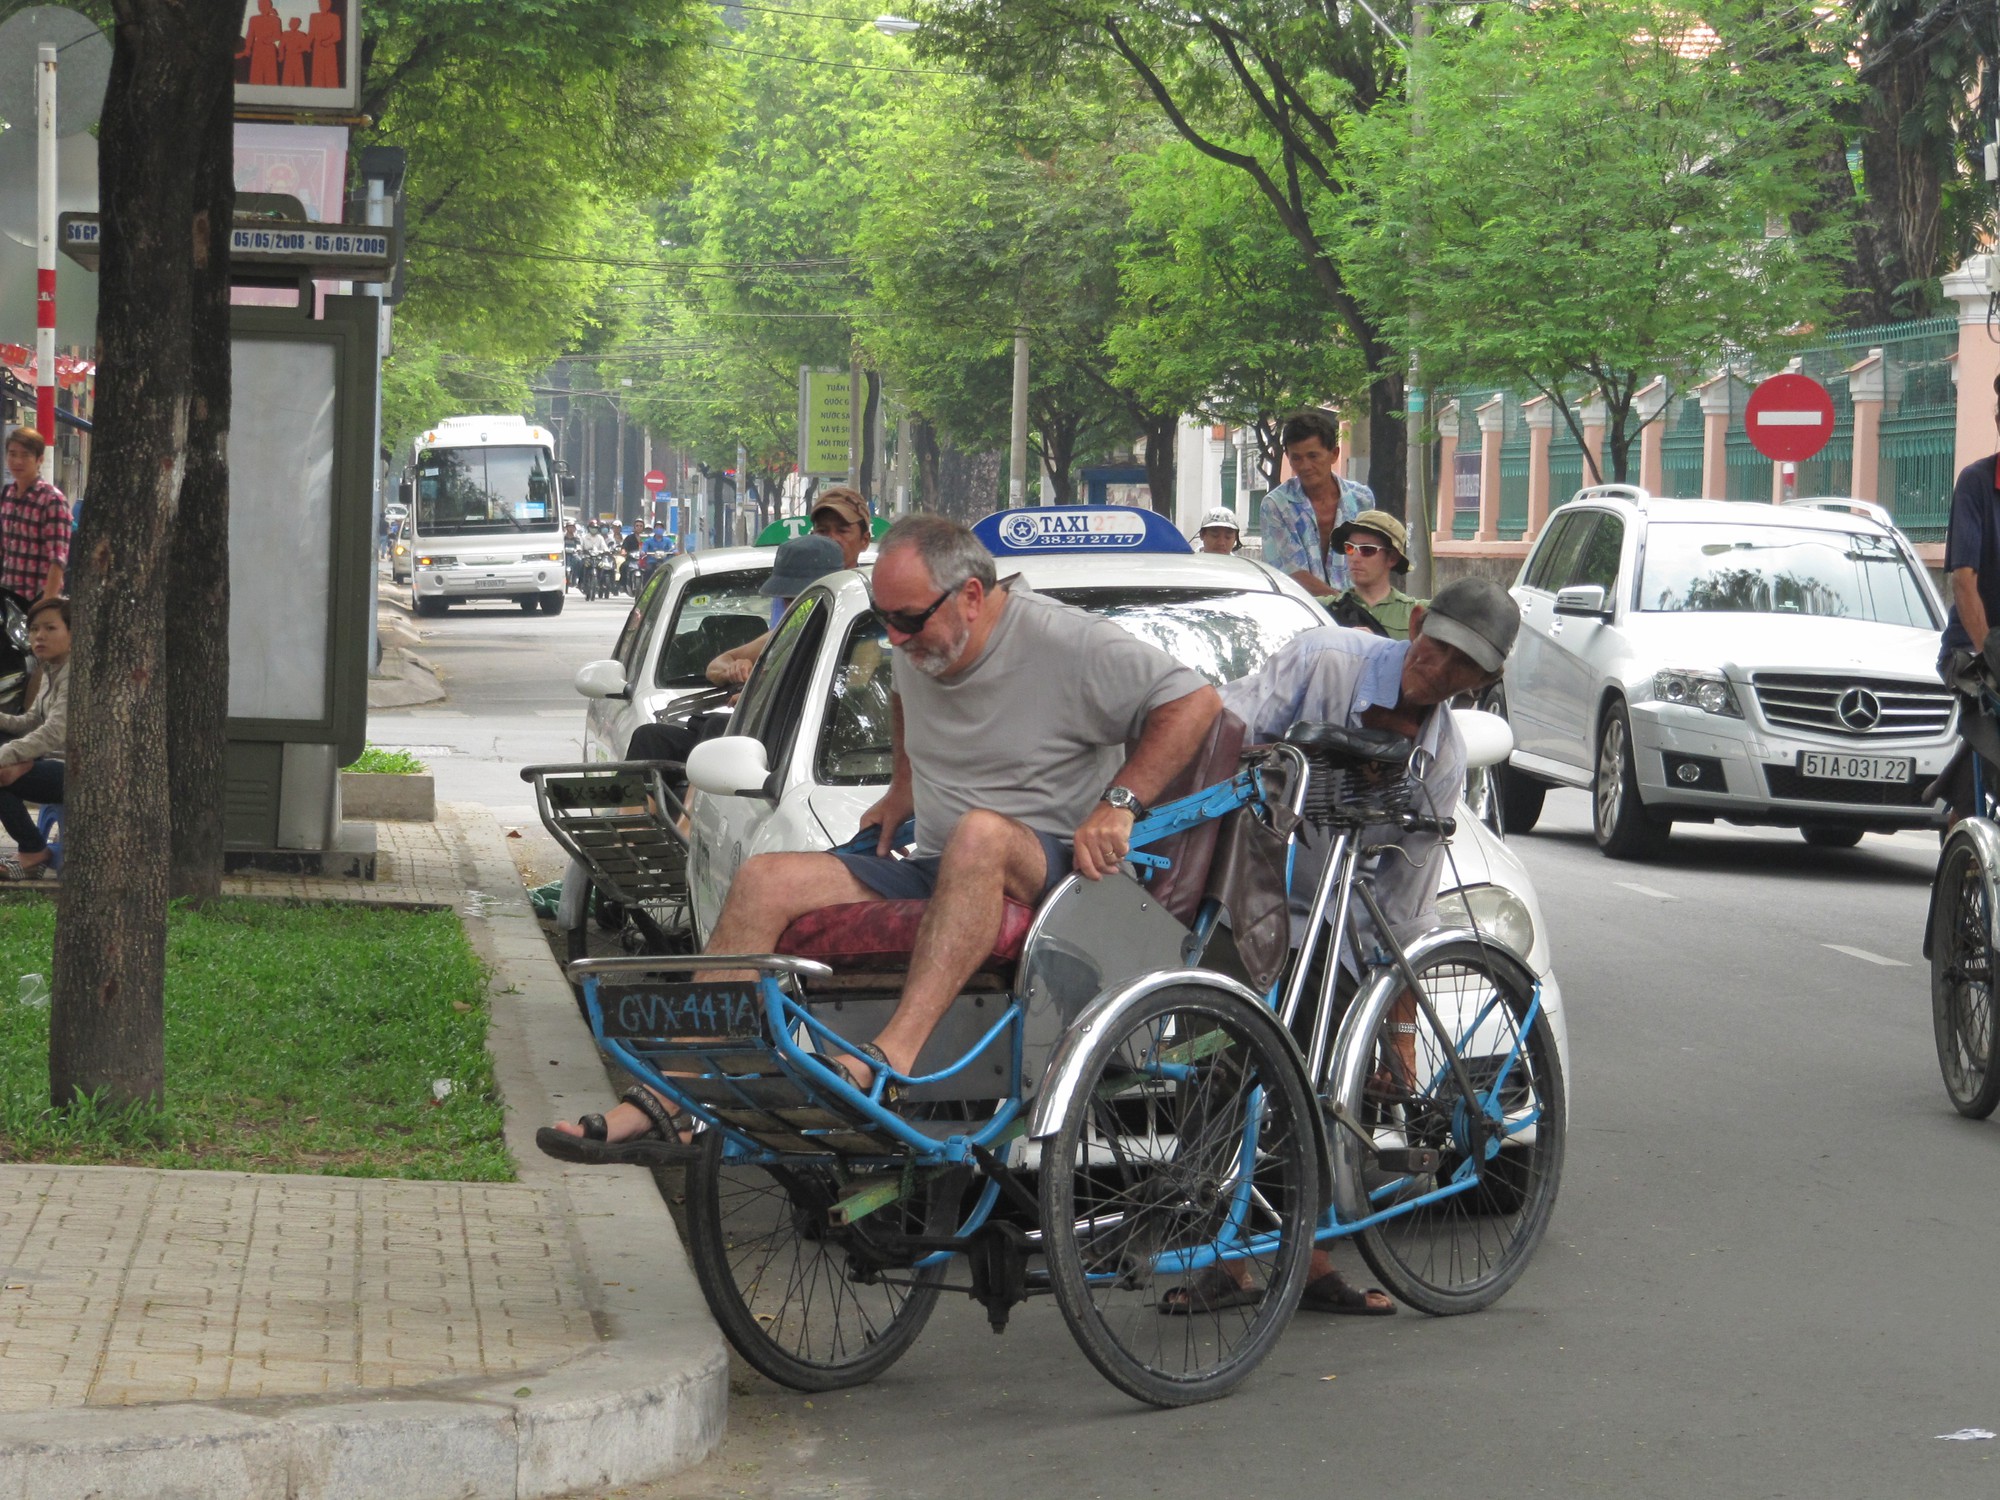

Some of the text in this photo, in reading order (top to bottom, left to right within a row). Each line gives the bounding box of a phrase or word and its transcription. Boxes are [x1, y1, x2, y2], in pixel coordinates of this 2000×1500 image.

[83, 224, 98, 240] GP
[234, 231, 305, 250] 05/05/2008
[314, 234, 385, 254] 05/05/2009
[839, 453, 848, 461] 20
[1040, 516, 1089, 533] TAXI
[1040, 534, 1134, 544] 38.27 27 77
[1807, 755, 1906, 780] 51A-031.22
[619, 992, 760, 1032] GVX-447A
